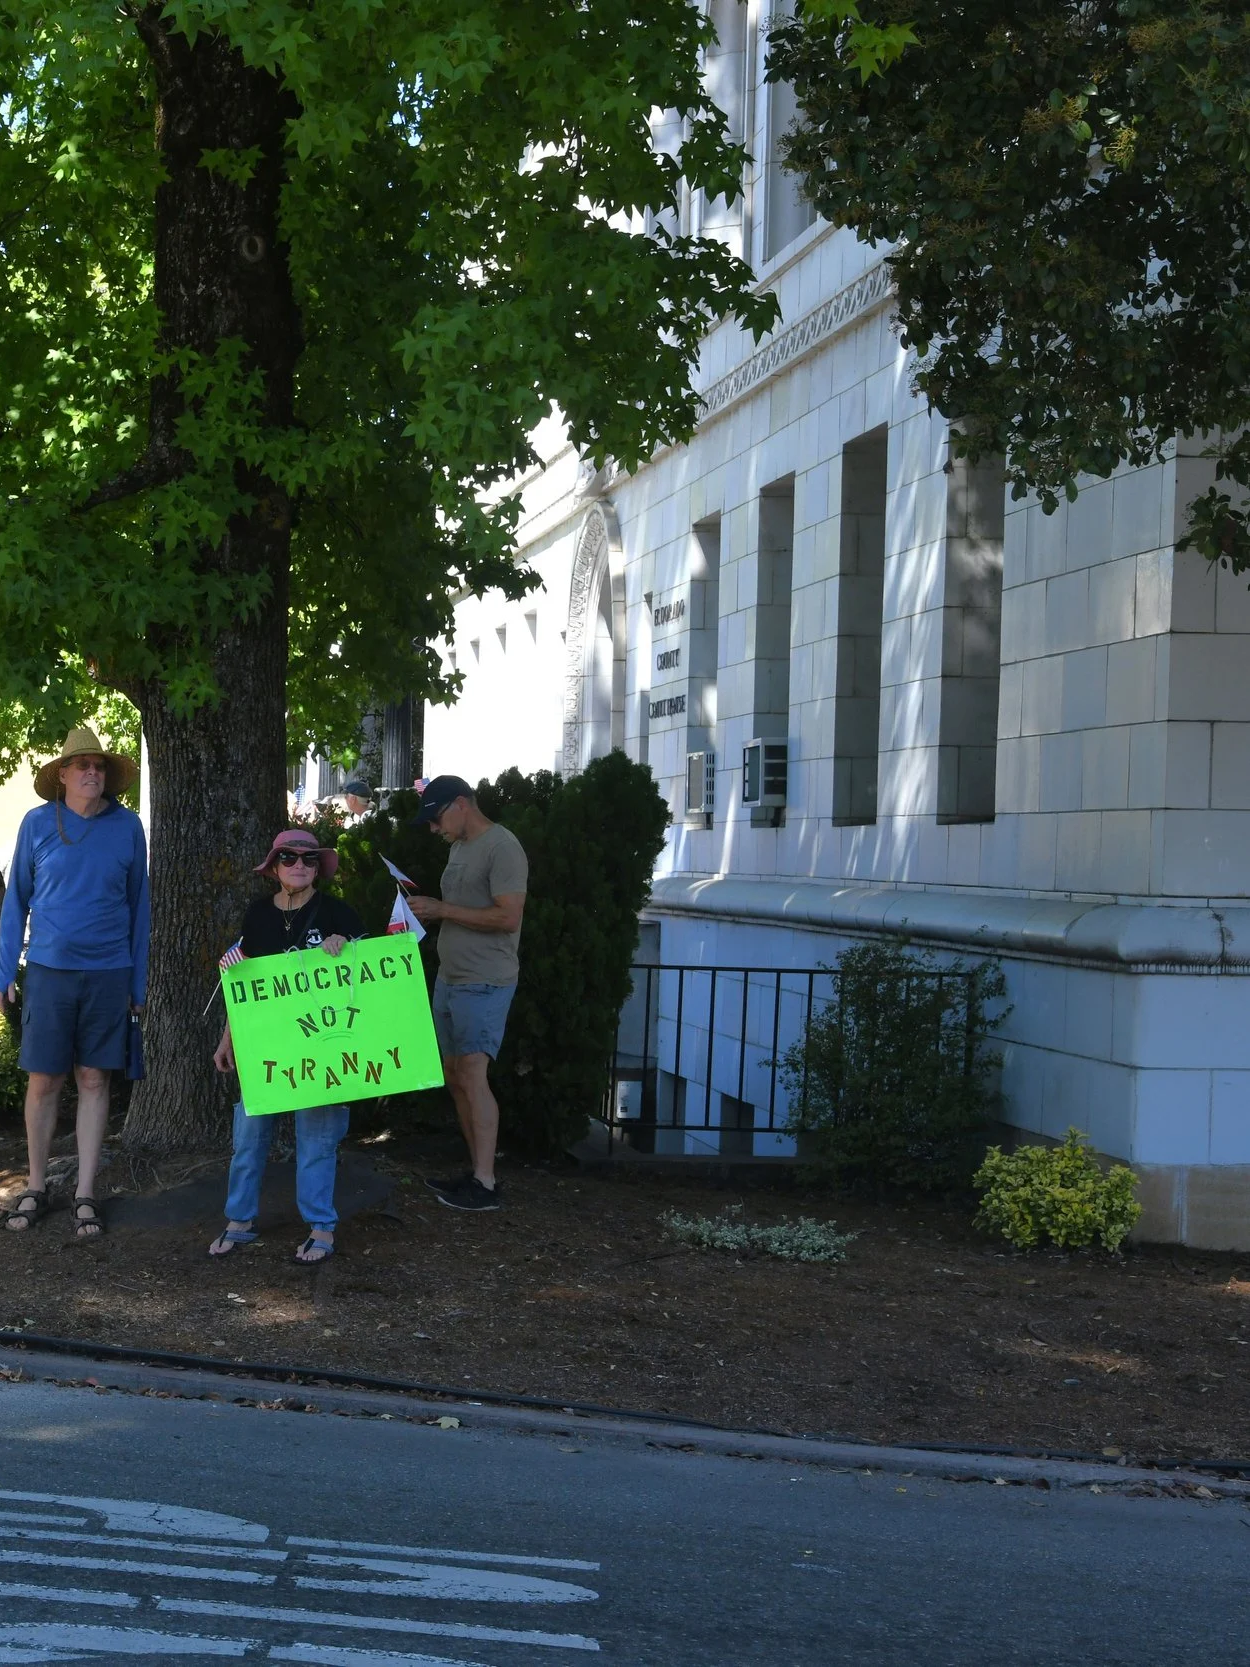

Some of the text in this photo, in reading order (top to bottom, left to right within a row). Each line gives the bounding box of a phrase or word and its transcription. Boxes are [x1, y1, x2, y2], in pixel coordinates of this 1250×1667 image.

[230, 953, 413, 1004] DEMOCRACY
[296, 1005, 360, 1038] NOT
[263, 1047, 401, 1089] TYRANNY
